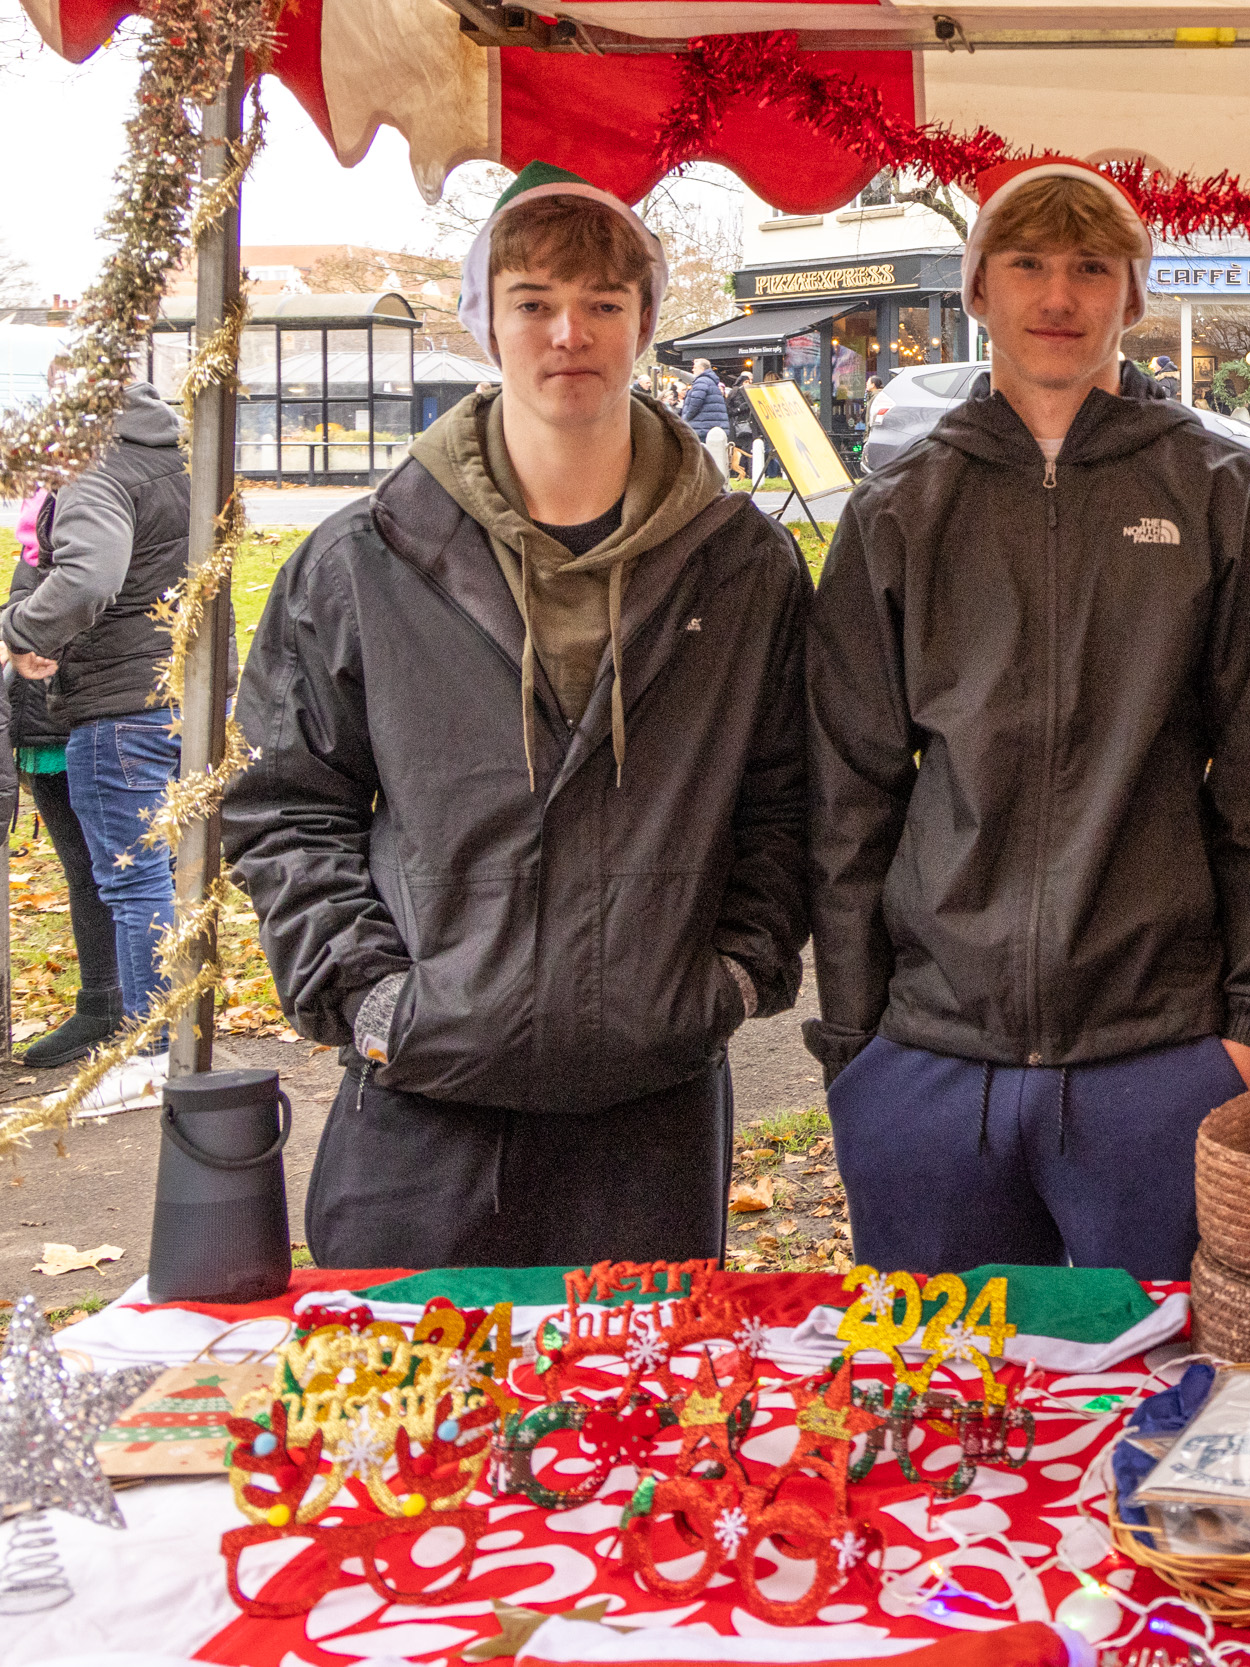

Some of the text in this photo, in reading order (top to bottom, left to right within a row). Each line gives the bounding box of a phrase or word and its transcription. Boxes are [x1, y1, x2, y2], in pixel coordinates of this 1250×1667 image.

[1156, 263, 1242, 286] CAFFÈ
[758, 398, 804, 420] Diversion
[1123, 526, 1161, 536] NORTH
[1140, 518, 1161, 526] THE
[1133, 535, 1161, 543] FACE
[563, 1258, 719, 1303] Merry
[836, 1264, 1017, 1358] 2024
